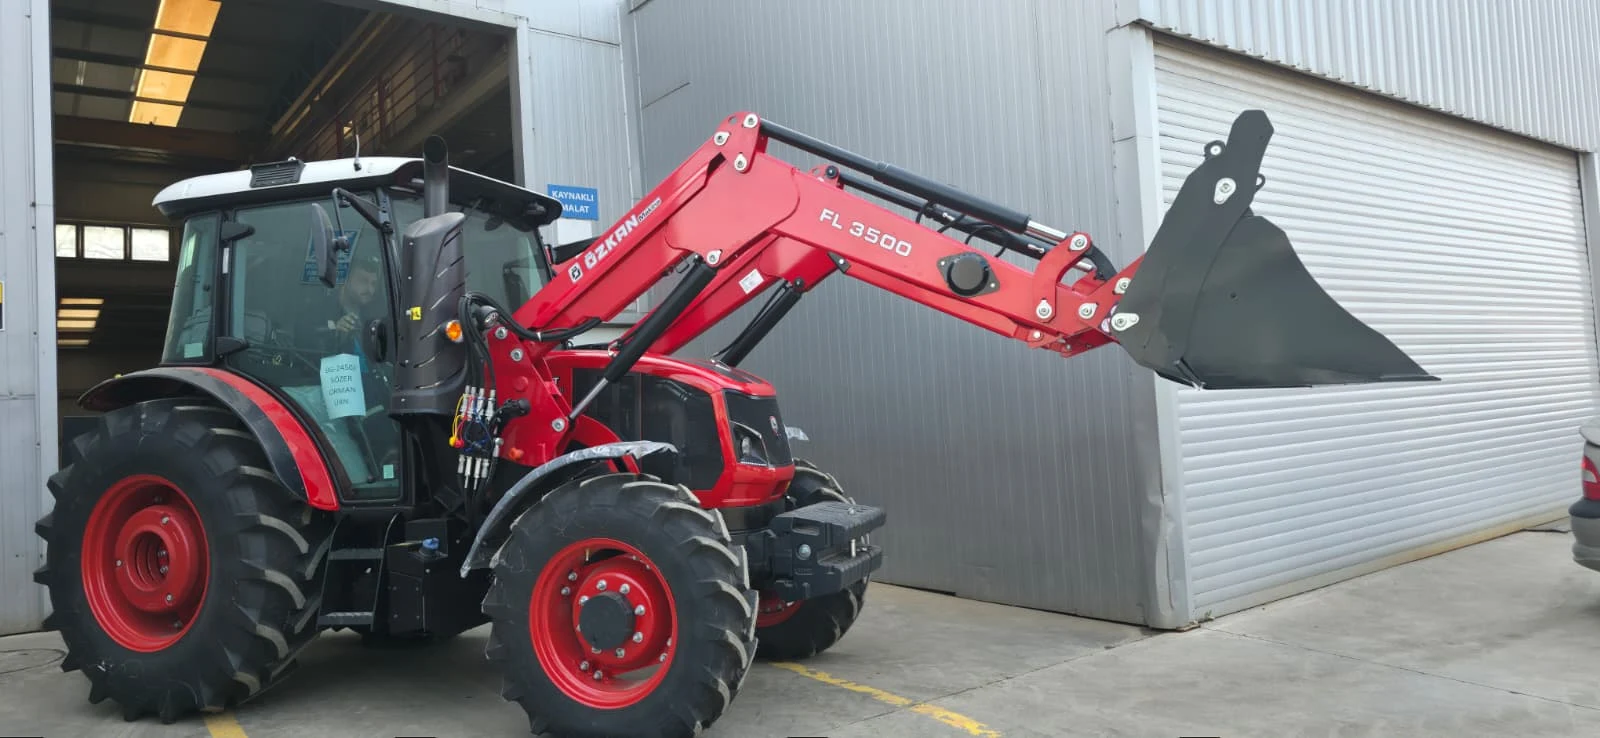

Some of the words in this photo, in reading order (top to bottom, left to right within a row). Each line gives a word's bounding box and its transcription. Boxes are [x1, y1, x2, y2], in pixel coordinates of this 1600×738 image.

[551, 190, 594, 202] KAYNAKLI
[562, 203, 590, 213] MALAT
[584, 214, 639, 269] ÖZKAN
[820, 208, 842, 229] FL
[849, 221, 912, 257] 3500
